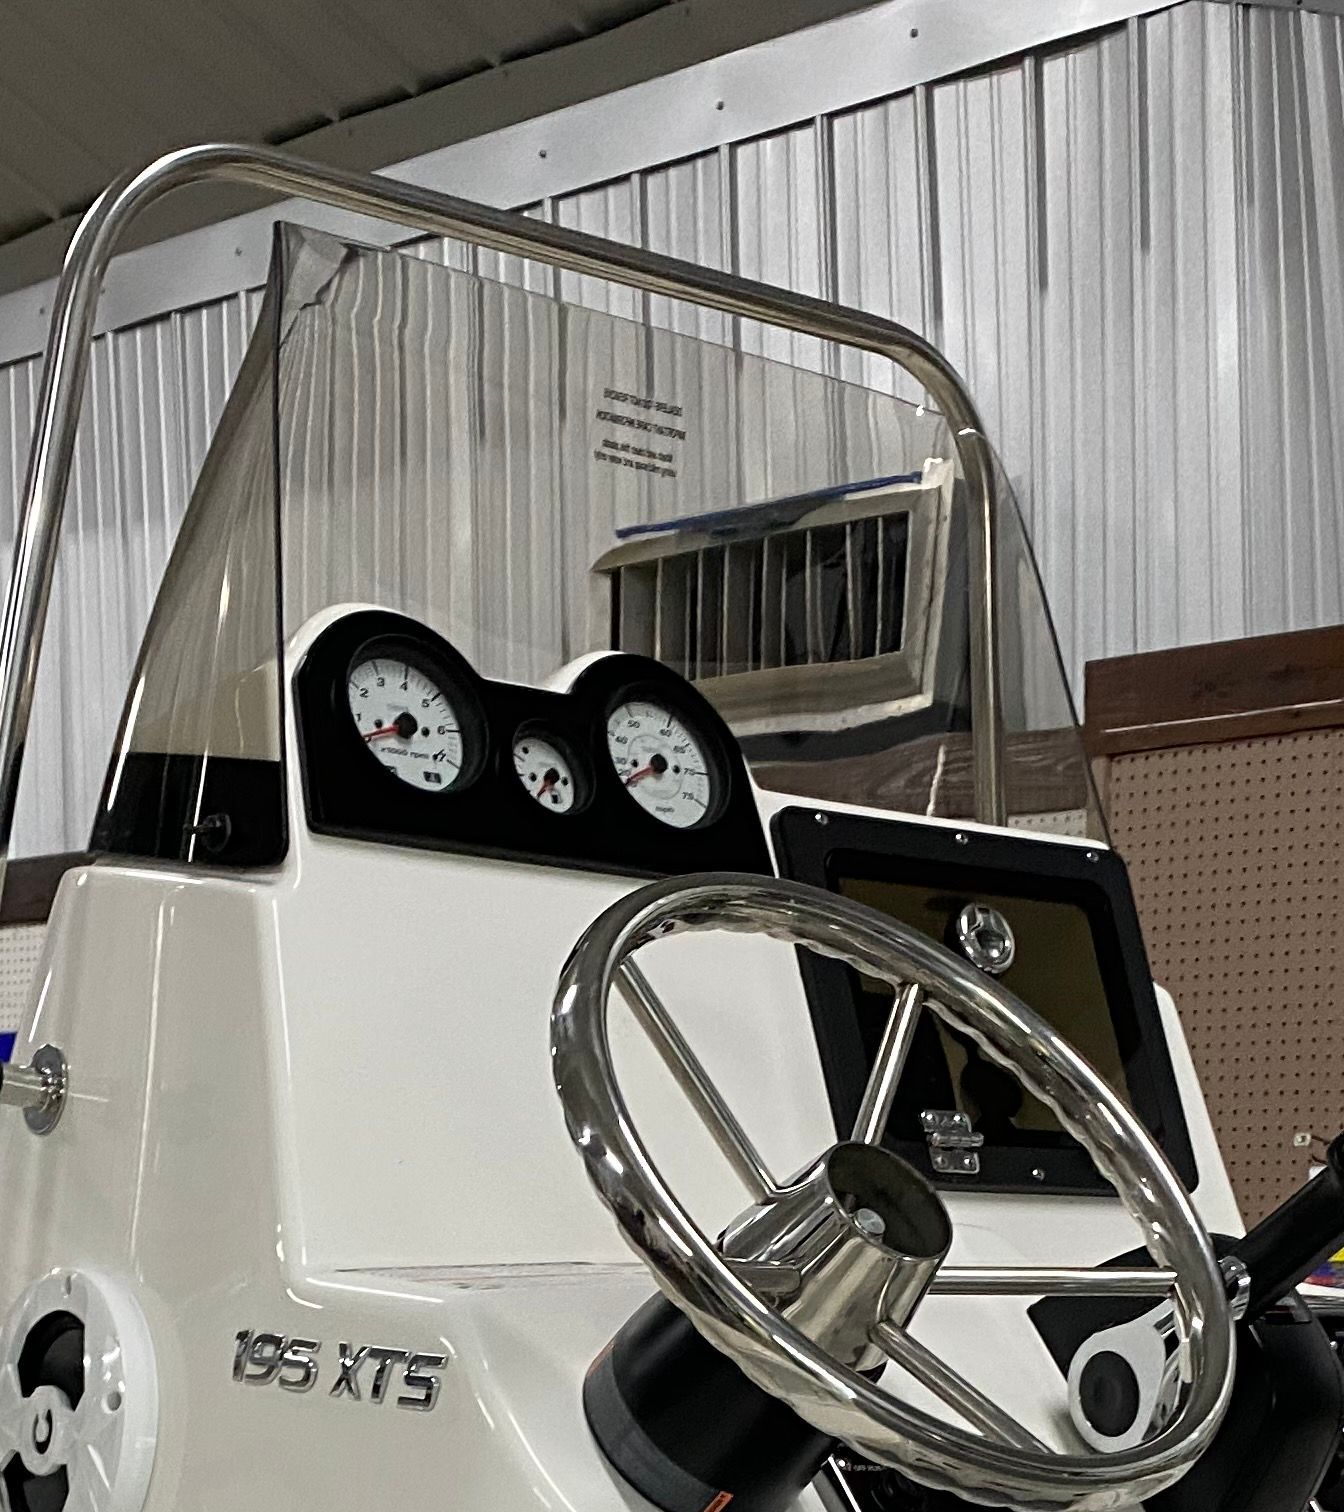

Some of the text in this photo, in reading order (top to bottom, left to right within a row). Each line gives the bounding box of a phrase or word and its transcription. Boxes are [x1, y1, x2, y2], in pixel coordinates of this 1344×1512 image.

[376, 677, 385, 687] 3
[399, 681, 408, 691] 4
[359, 688, 369, 698] 2
[232, 1328, 449, 1412] 195 XTS
